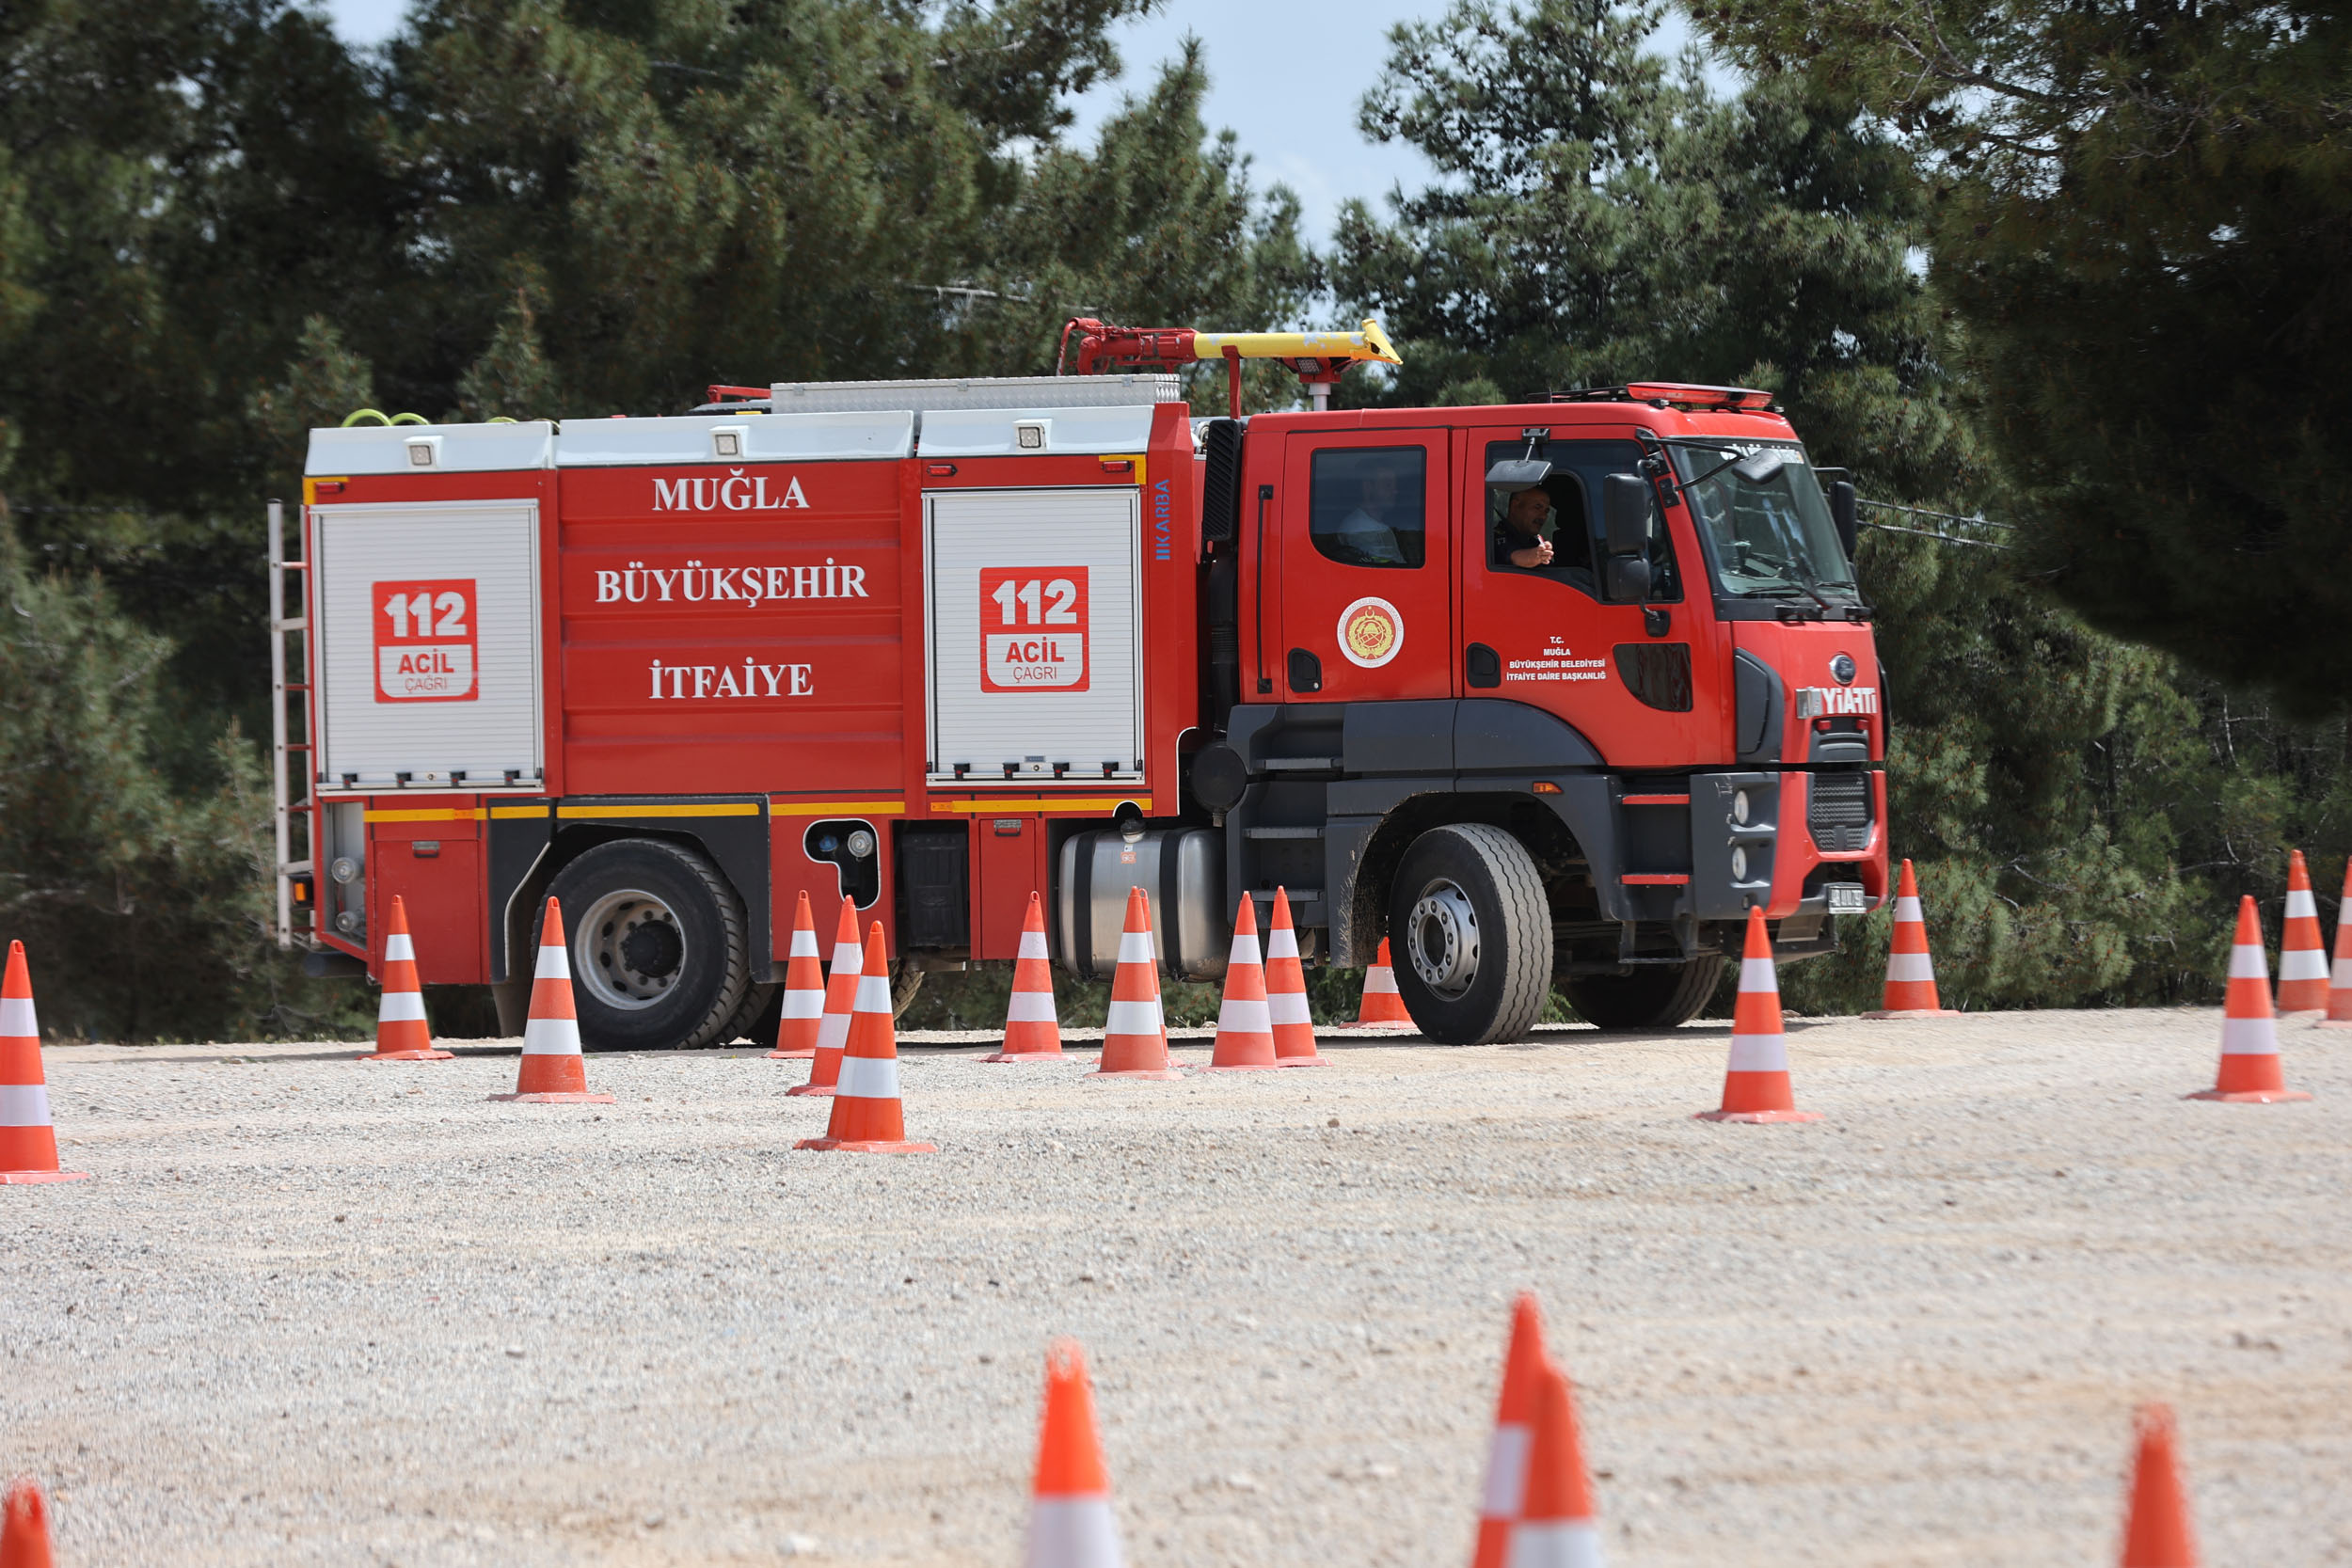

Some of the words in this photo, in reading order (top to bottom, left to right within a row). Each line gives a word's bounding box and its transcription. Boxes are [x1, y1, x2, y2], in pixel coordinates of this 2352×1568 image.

[651, 467, 810, 511] MUĞLA
[595, 558, 869, 608] BÜYÜKŞEHİR
[384, 591, 467, 637] 112
[992, 578, 1077, 625] 112
[1005, 636, 1065, 663] ACİL
[1543, 646, 1571, 657] MUĞLA
[1549, 636, 1565, 644] T.C.
[398, 648, 455, 674] ACİL
[1509, 659, 1560, 670] BÜYÜKŞEHİR
[1561, 658, 1606, 668] BELEDİYESİ
[648, 656, 814, 699] İTFAİYE
[1506, 672, 1536, 681] İTFAİYE
[1537, 672, 1560, 680] DAİRE
